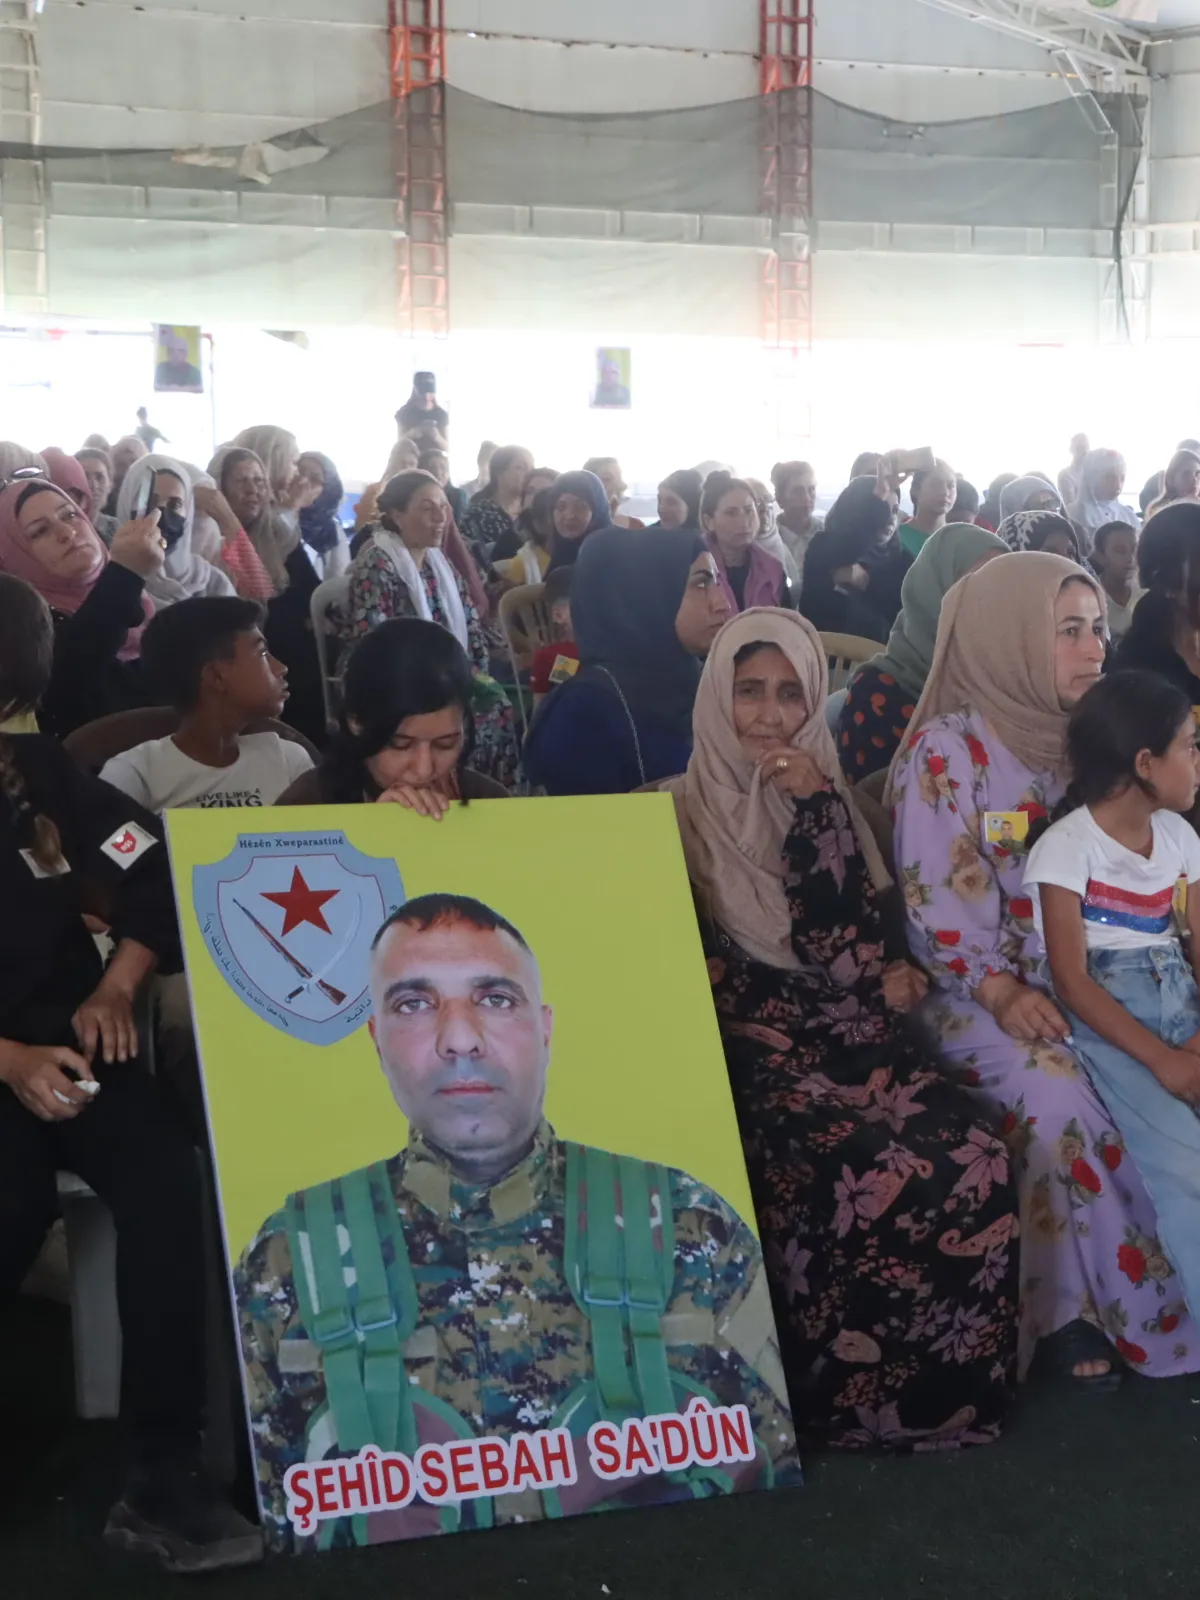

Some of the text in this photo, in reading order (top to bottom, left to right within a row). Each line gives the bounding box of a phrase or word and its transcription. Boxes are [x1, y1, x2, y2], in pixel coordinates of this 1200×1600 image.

[196, 791, 221, 803] LIVE
[239, 839, 272, 849] Hêzên
[288, 1403, 751, 1529] ŞEHÎD SEBAH SA'DÛN
